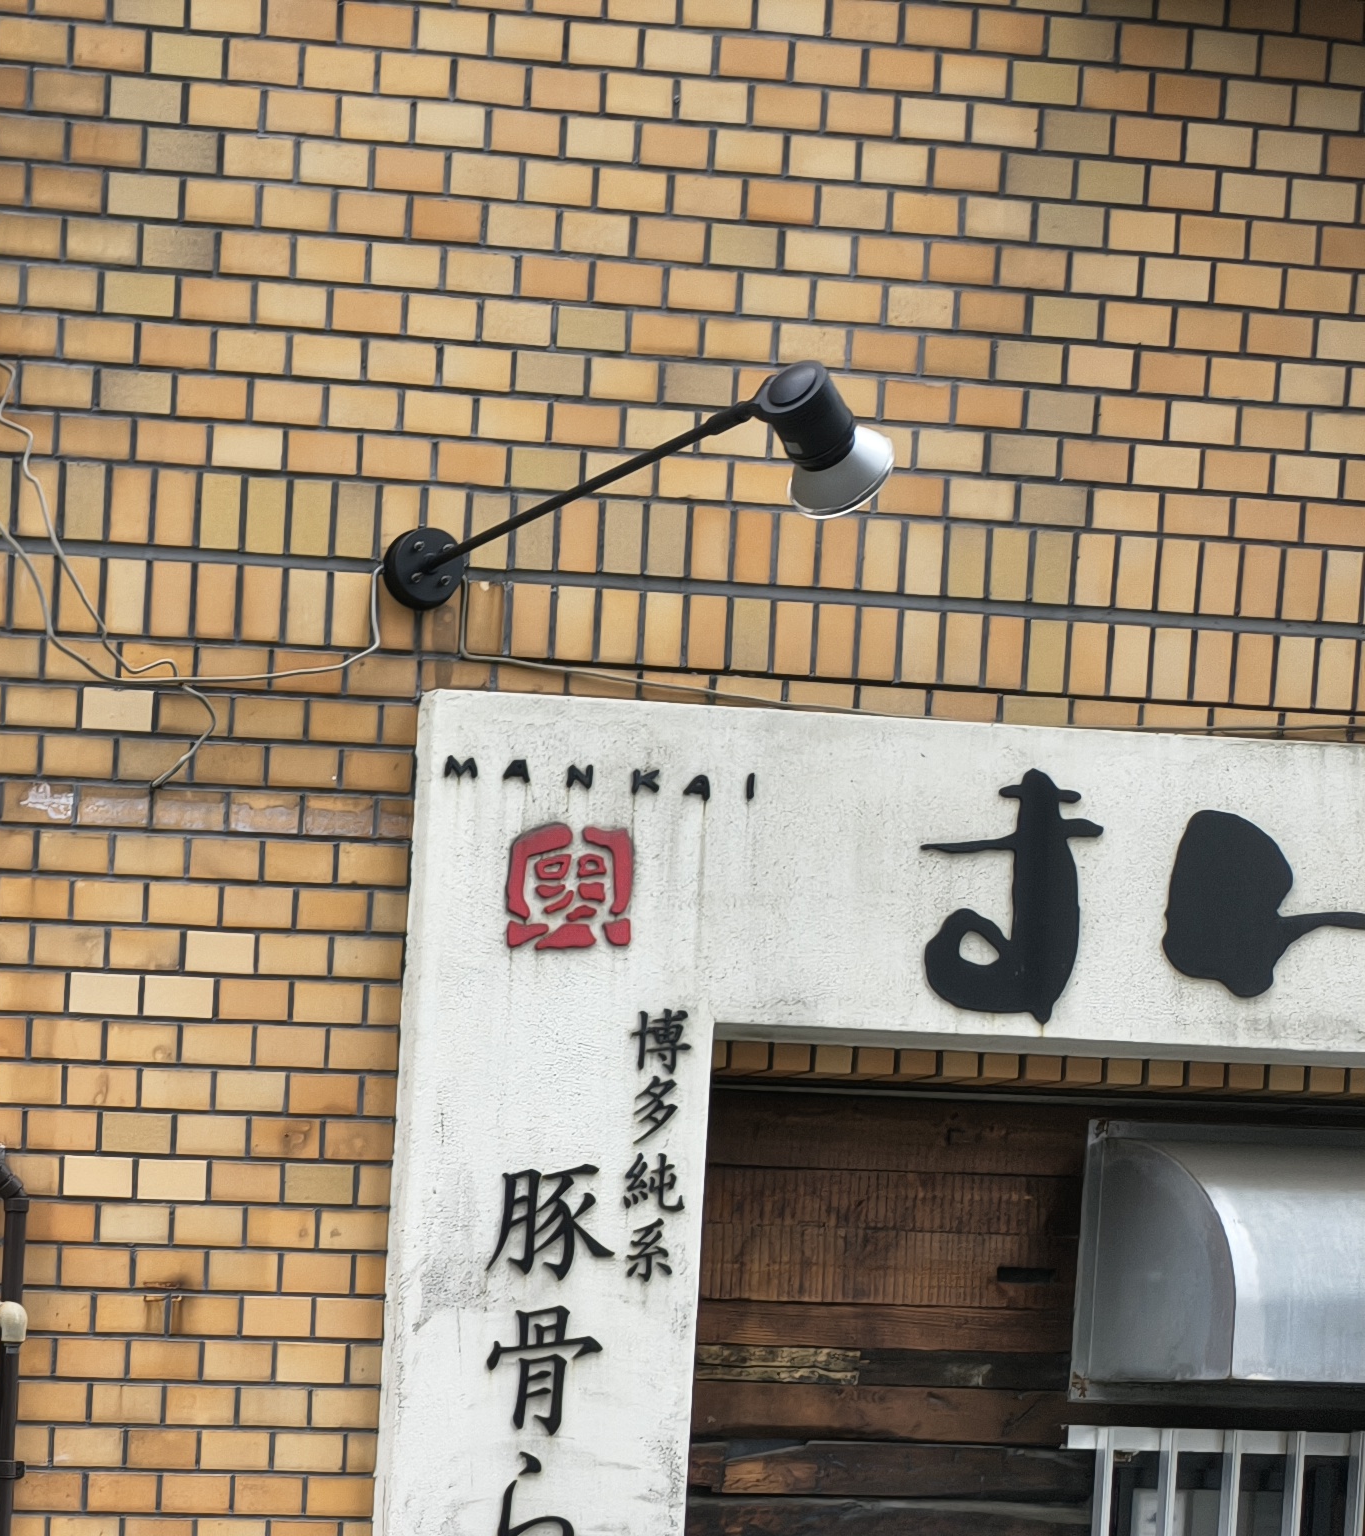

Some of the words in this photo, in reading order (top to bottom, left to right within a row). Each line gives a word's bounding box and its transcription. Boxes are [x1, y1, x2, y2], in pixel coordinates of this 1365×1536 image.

[442, 754, 757, 803] MANKAI
[623, 1008, 692, 1283] 博多純系
